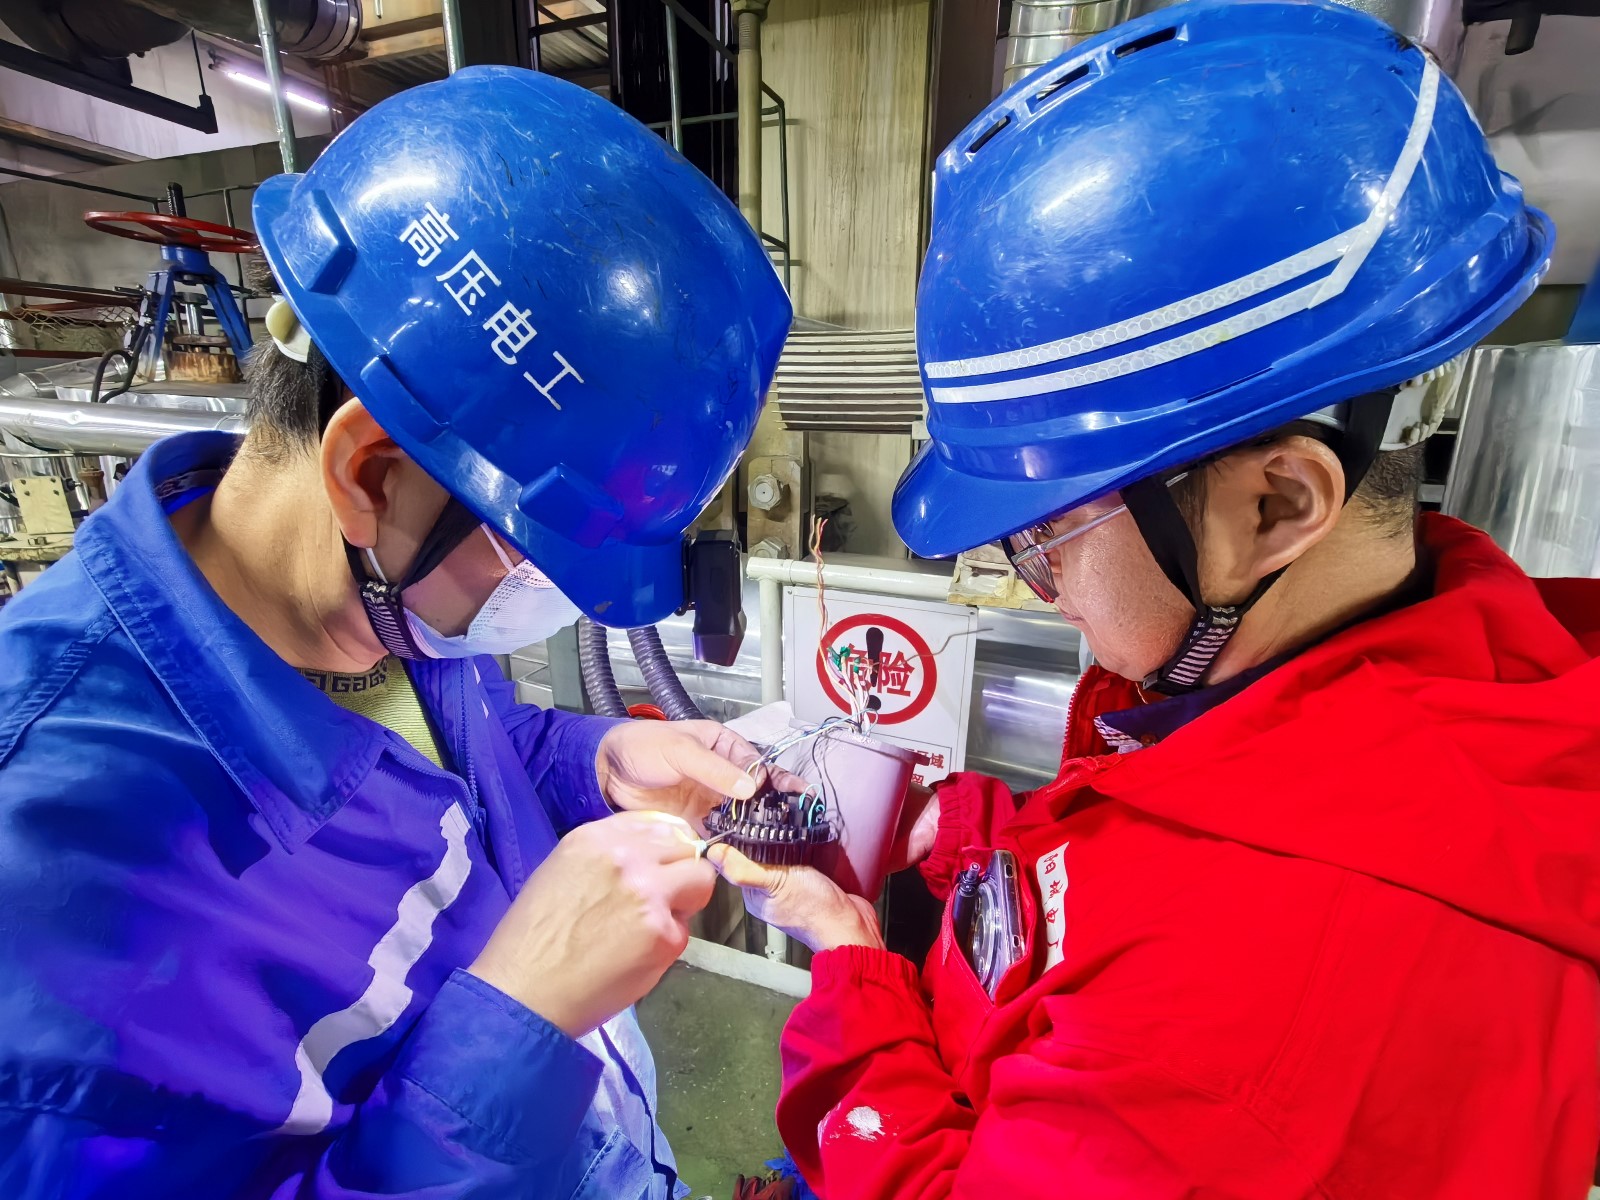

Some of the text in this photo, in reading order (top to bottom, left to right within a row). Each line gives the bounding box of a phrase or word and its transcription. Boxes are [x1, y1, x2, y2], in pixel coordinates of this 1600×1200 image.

[399, 202, 584, 410] 高压电工
[845, 643, 915, 697] 危险
